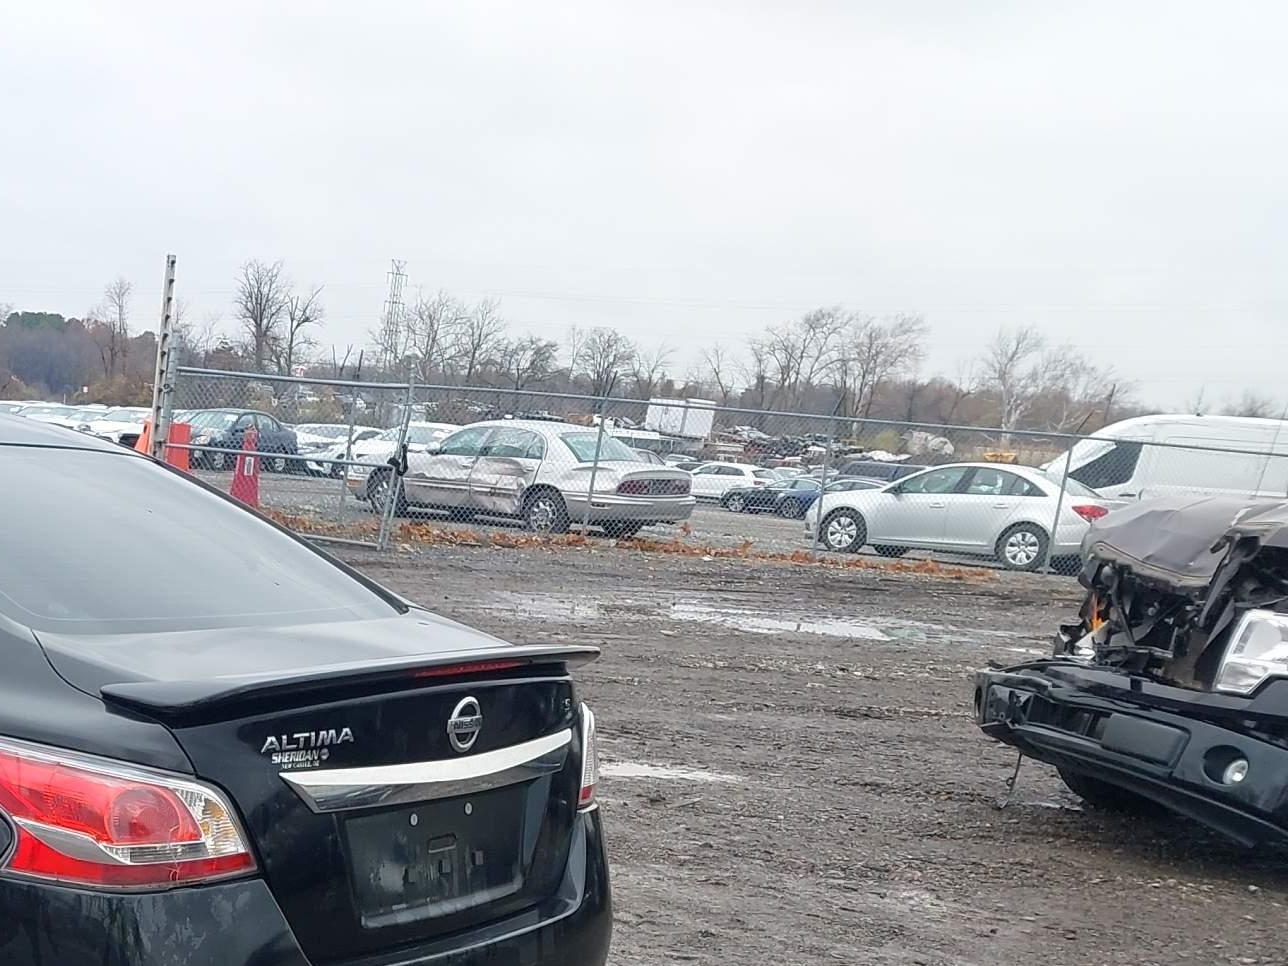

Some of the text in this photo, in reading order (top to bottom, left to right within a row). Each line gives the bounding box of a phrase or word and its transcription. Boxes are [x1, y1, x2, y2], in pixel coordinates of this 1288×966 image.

[451, 716, 482, 731] NISSAN
[260, 726, 355, 754] ALTIMA
[271, 749, 320, 764] SHERIDAN
